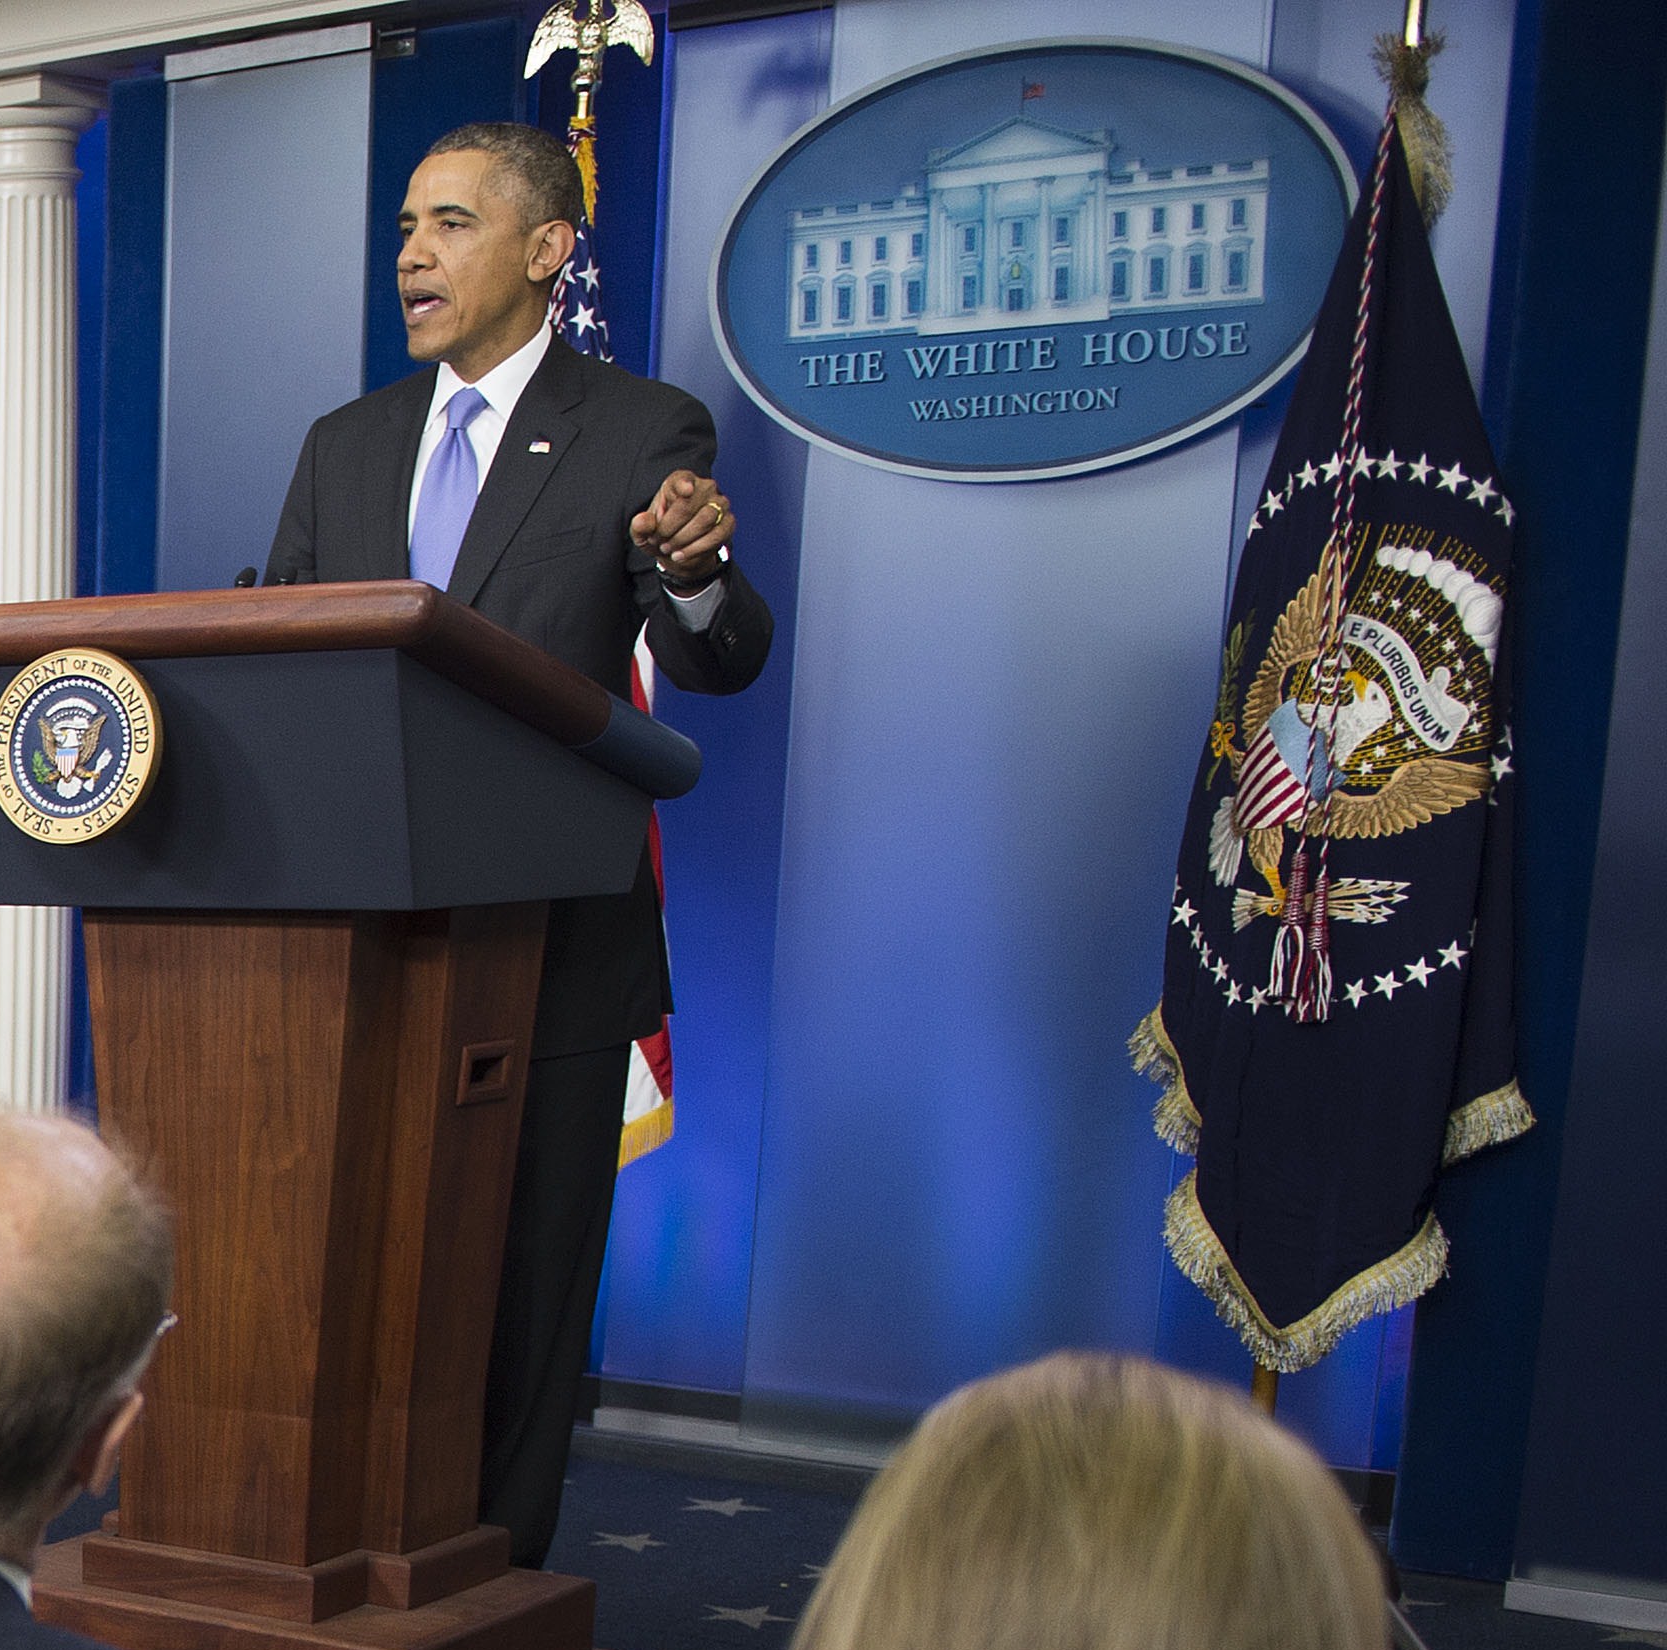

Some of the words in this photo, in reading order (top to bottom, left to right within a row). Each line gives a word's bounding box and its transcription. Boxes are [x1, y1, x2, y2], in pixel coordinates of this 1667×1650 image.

[799, 349, 885, 387] THE
[903, 337, 1057, 380] WHITE
[1081, 321, 1249, 369] HOUSE
[908, 385, 1121, 423] WASHINGTON
[73, 659, 87, 671] OF
[91, 661, 113, 680] THE
[1349, 622, 1363, 638] E
[1363, 628, 1419, 699] PLURIBUS
[1409, 698, 1450, 743] UNUM
[116, 676, 150, 755] UNITED
[2, 785, 13, 798] OF
[82, 773, 140, 833] STATES
[13, 797, 53, 835] SEAL
